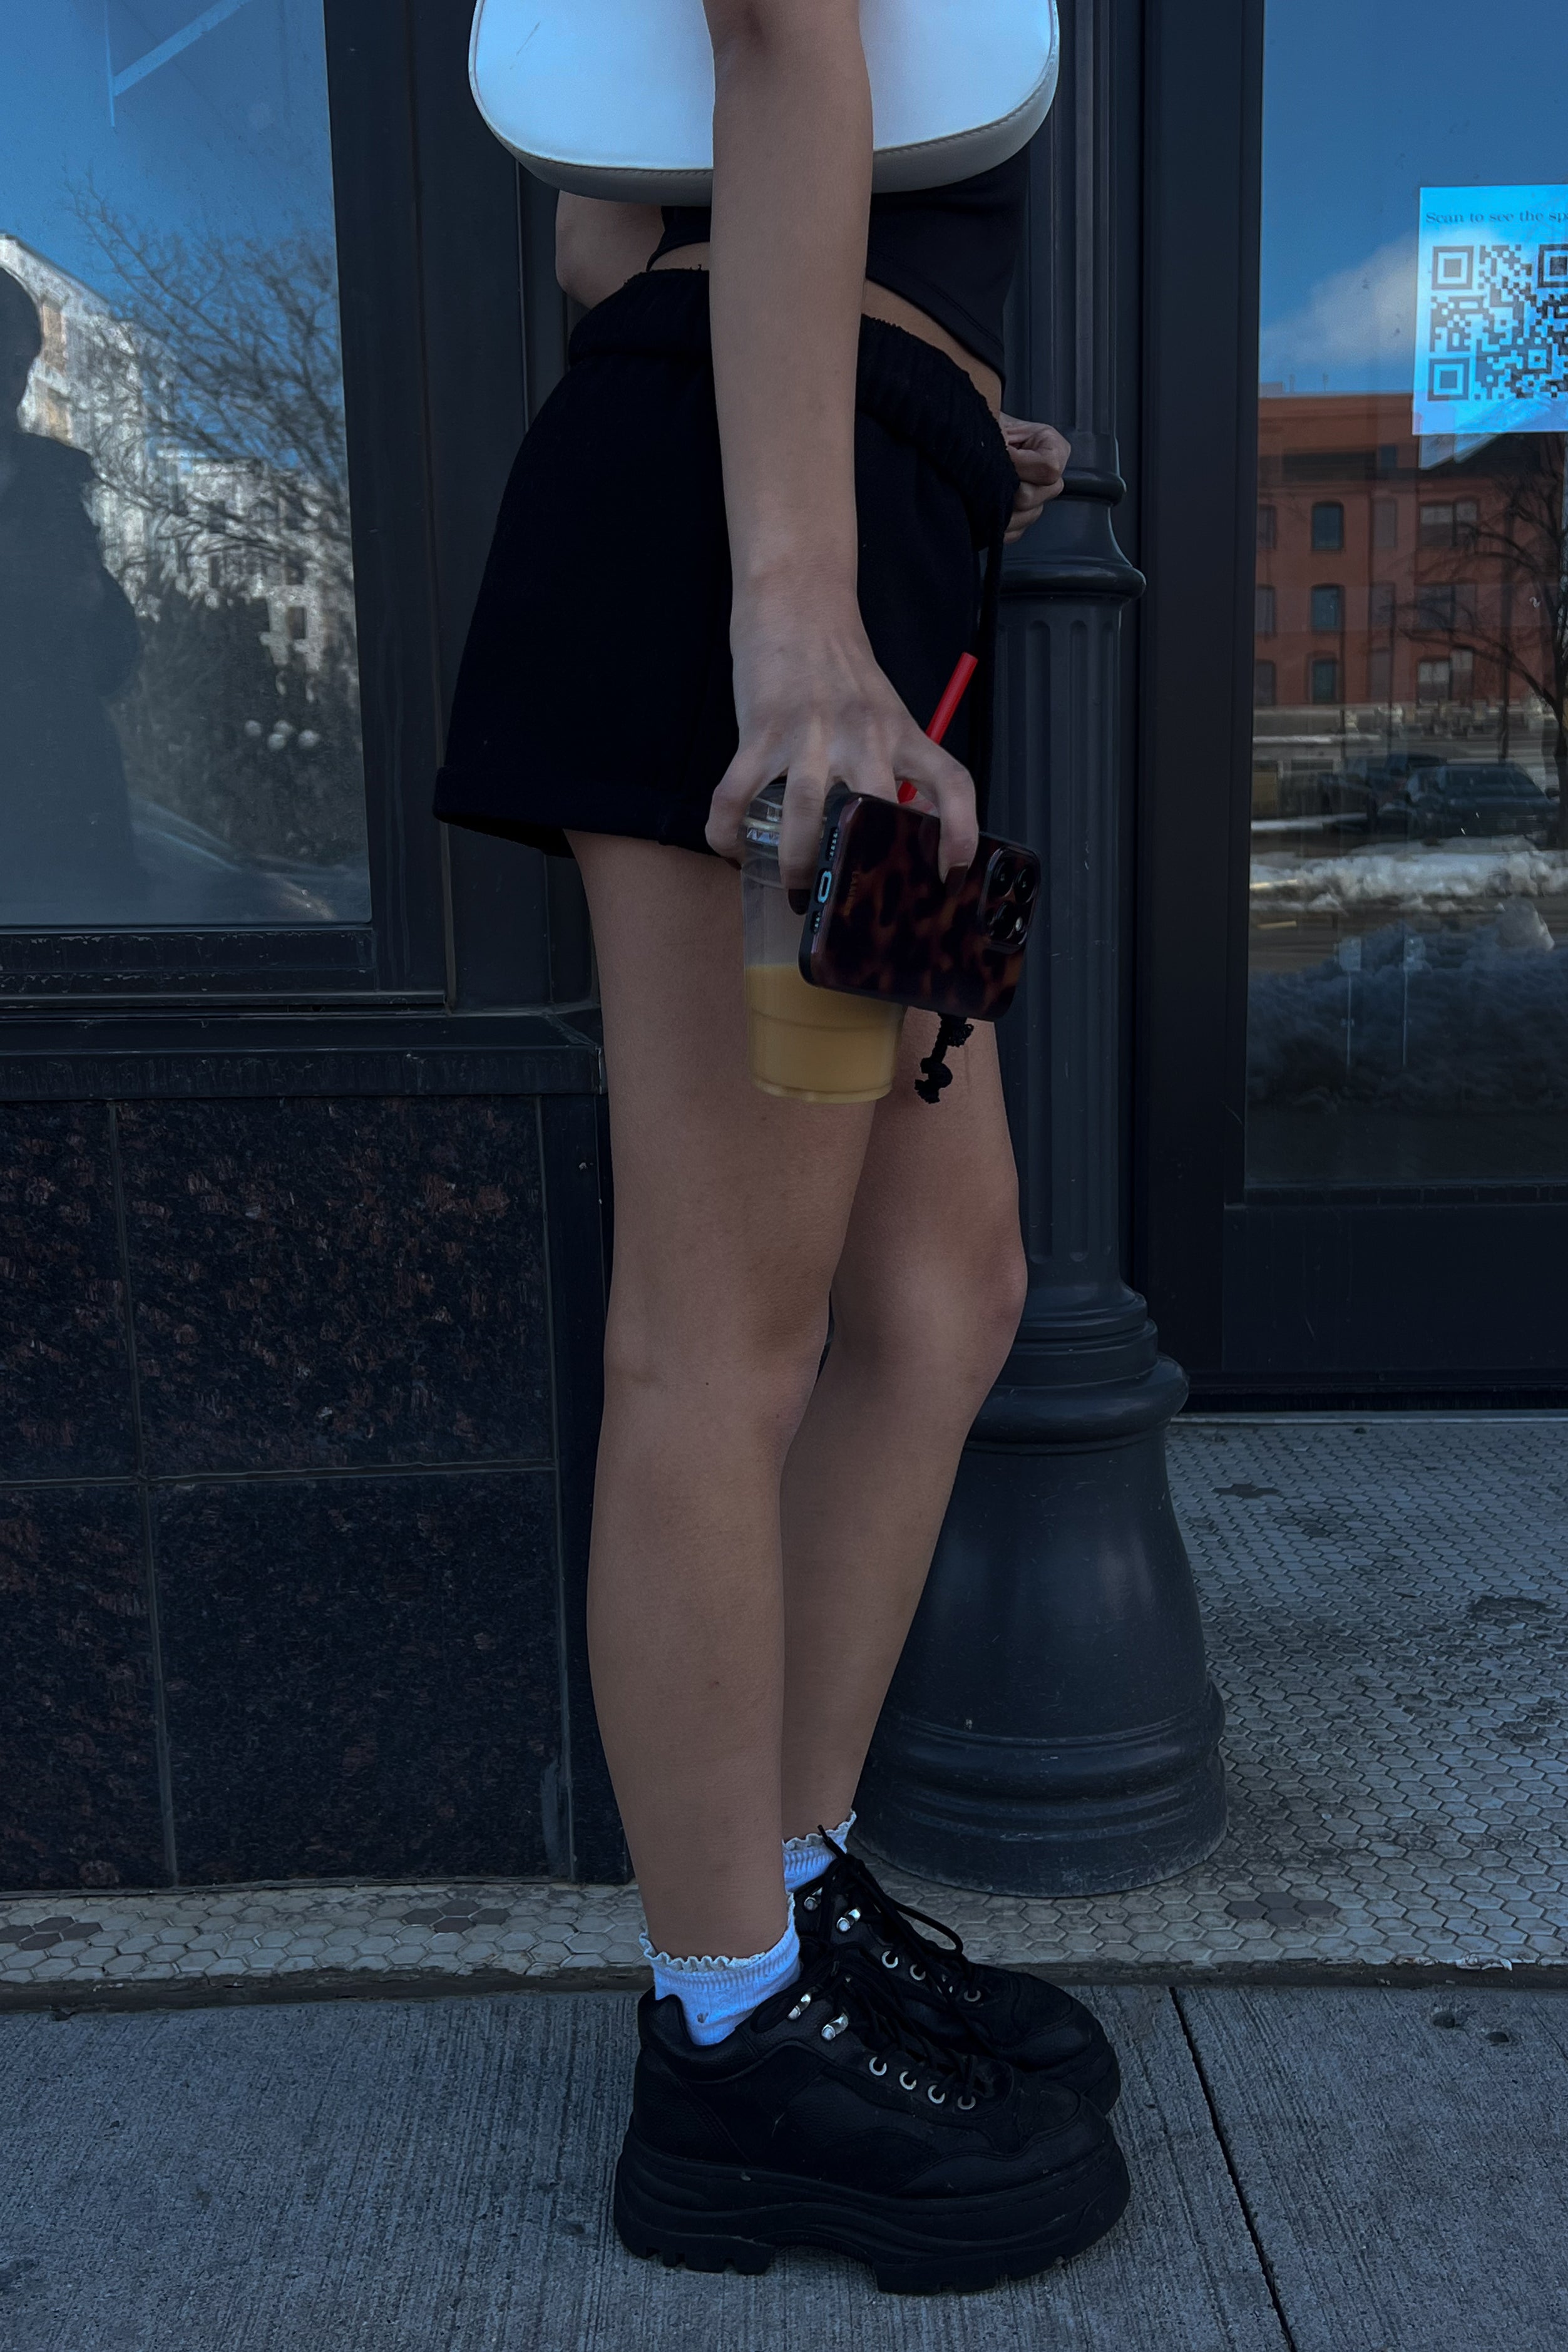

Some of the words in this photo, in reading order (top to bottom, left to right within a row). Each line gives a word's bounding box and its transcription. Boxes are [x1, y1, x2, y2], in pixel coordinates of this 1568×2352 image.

[1426, 212, 1464, 223] Scan
[1470, 212, 1484, 223] to
[1489, 212, 1514, 222] see
[1519, 210, 1544, 222] the
[1549, 212, 1568, 223] sp
